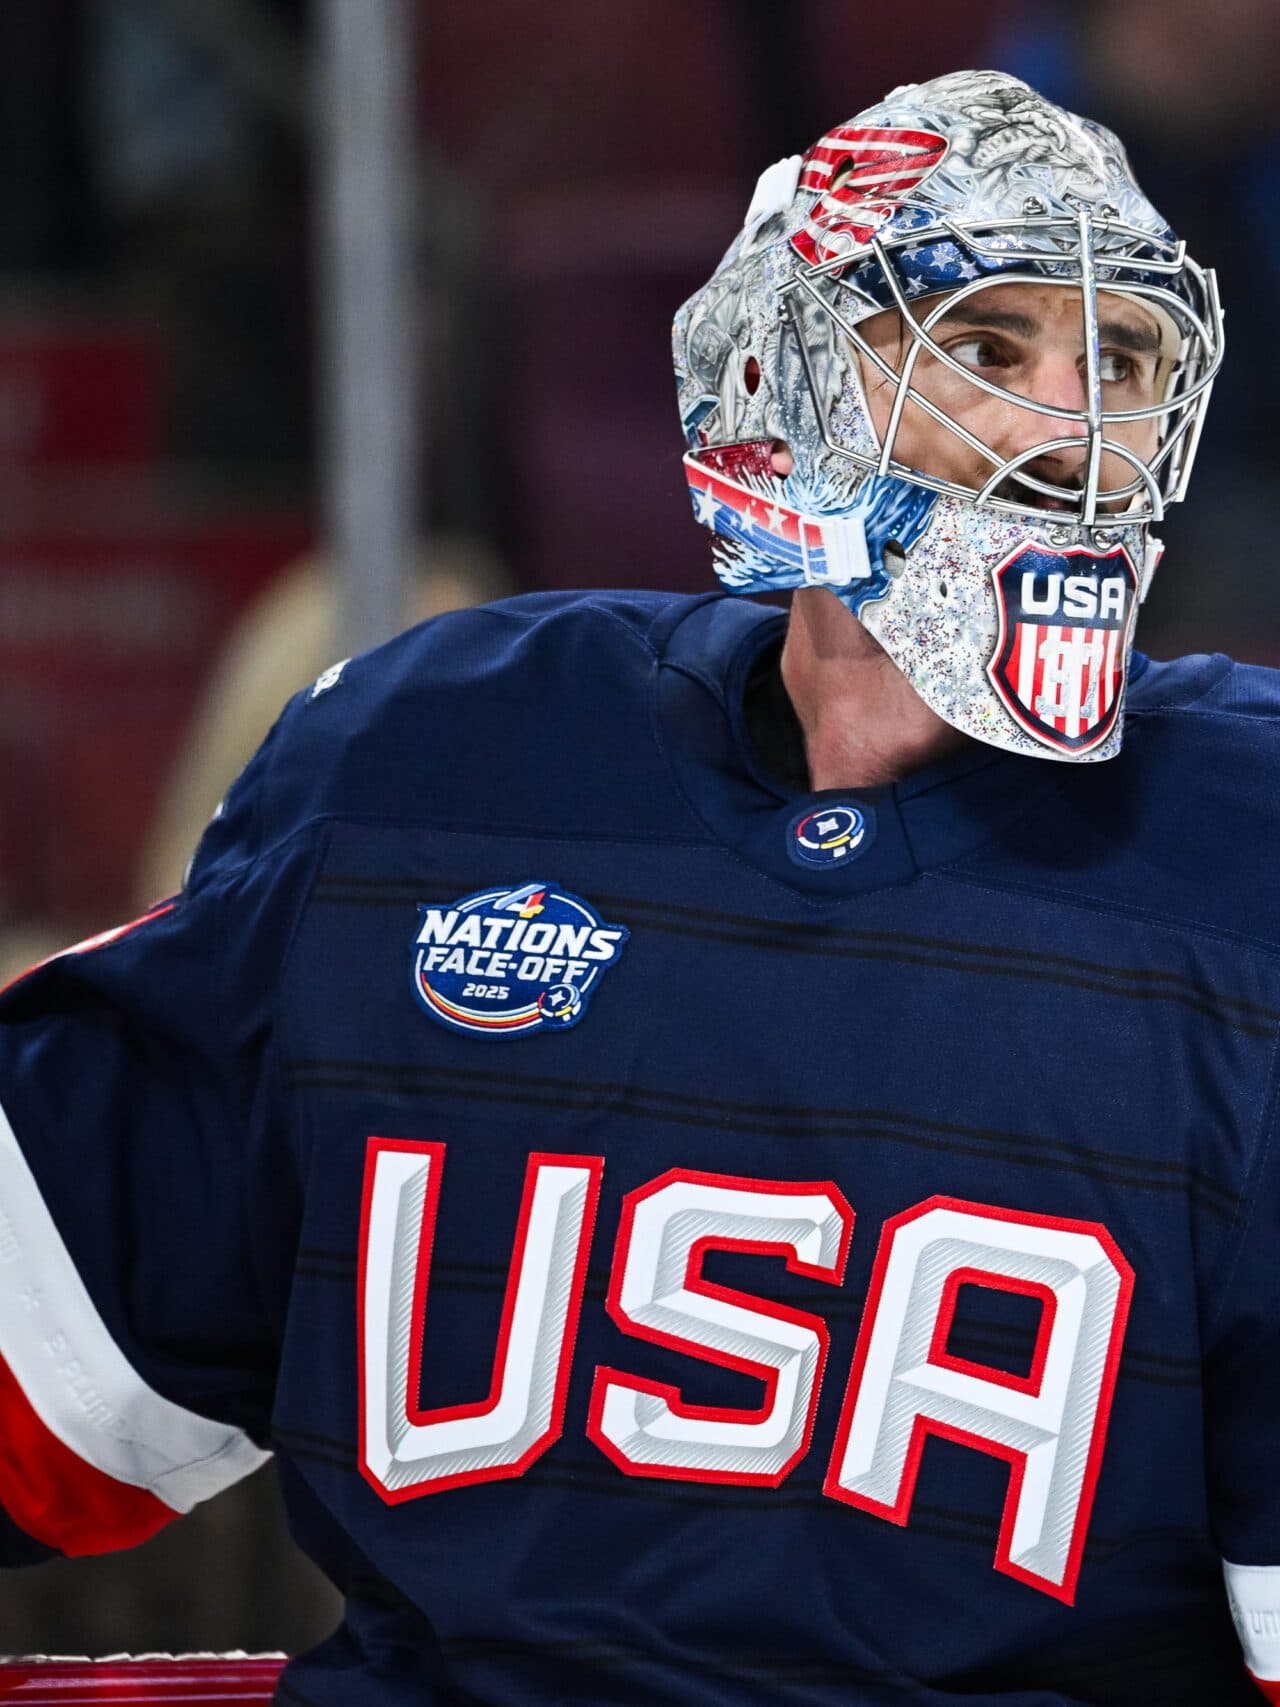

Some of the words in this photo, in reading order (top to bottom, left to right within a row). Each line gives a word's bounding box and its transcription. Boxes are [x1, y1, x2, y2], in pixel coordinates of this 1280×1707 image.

[1021, 572, 1126, 621] USA
[416, 909, 622, 961] NATIONS
[423, 947, 589, 983] FACE-OFF
[462, 983, 510, 1000] 2025
[357, 1136, 1136, 1607] USA
